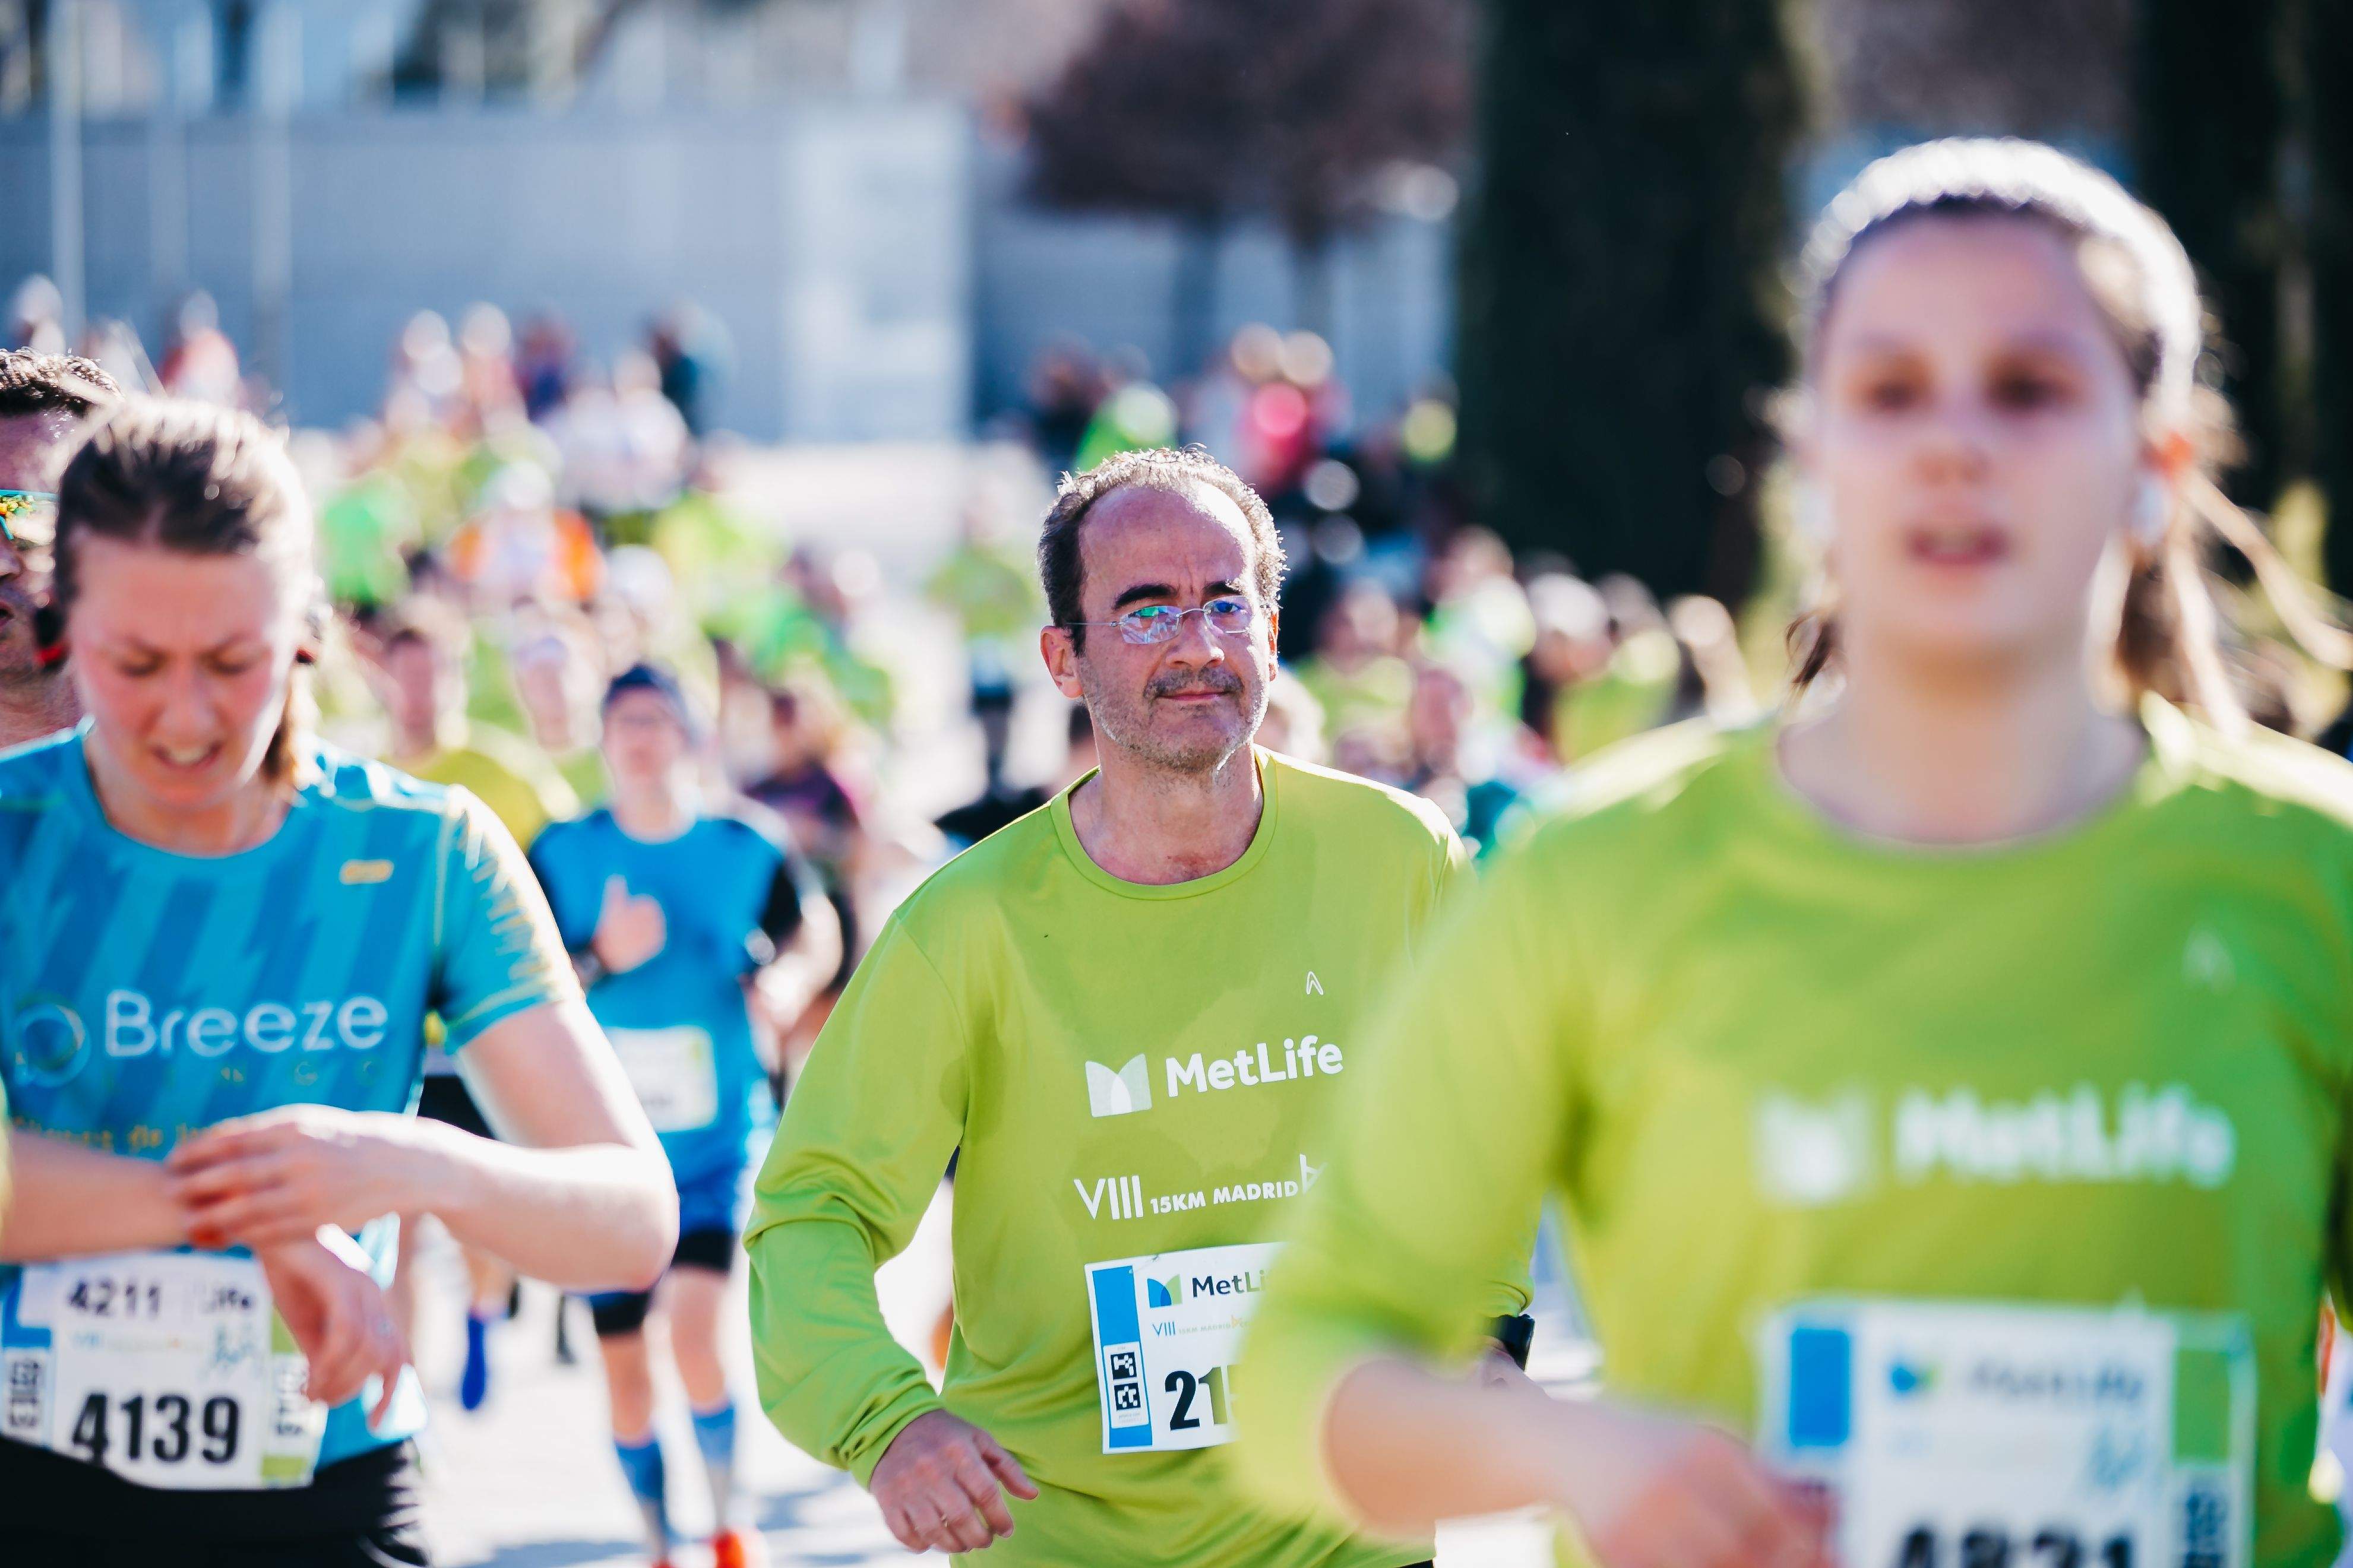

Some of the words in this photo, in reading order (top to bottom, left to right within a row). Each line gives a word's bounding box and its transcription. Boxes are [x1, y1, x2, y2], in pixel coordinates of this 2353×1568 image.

[105, 989, 390, 1058] Breeze
[1165, 1035, 1343, 1098] MetLife
[1074, 1175, 1144, 1220] VIII
[1150, 1192, 1206, 1215] 15KM
[1213, 1180, 1299, 1205] MADRID
[68, 1279, 161, 1316] 4211
[1193, 1269, 1267, 1298] MetLi
[1153, 1321, 1176, 1336] VIII
[71, 1393, 240, 1466] 4139
